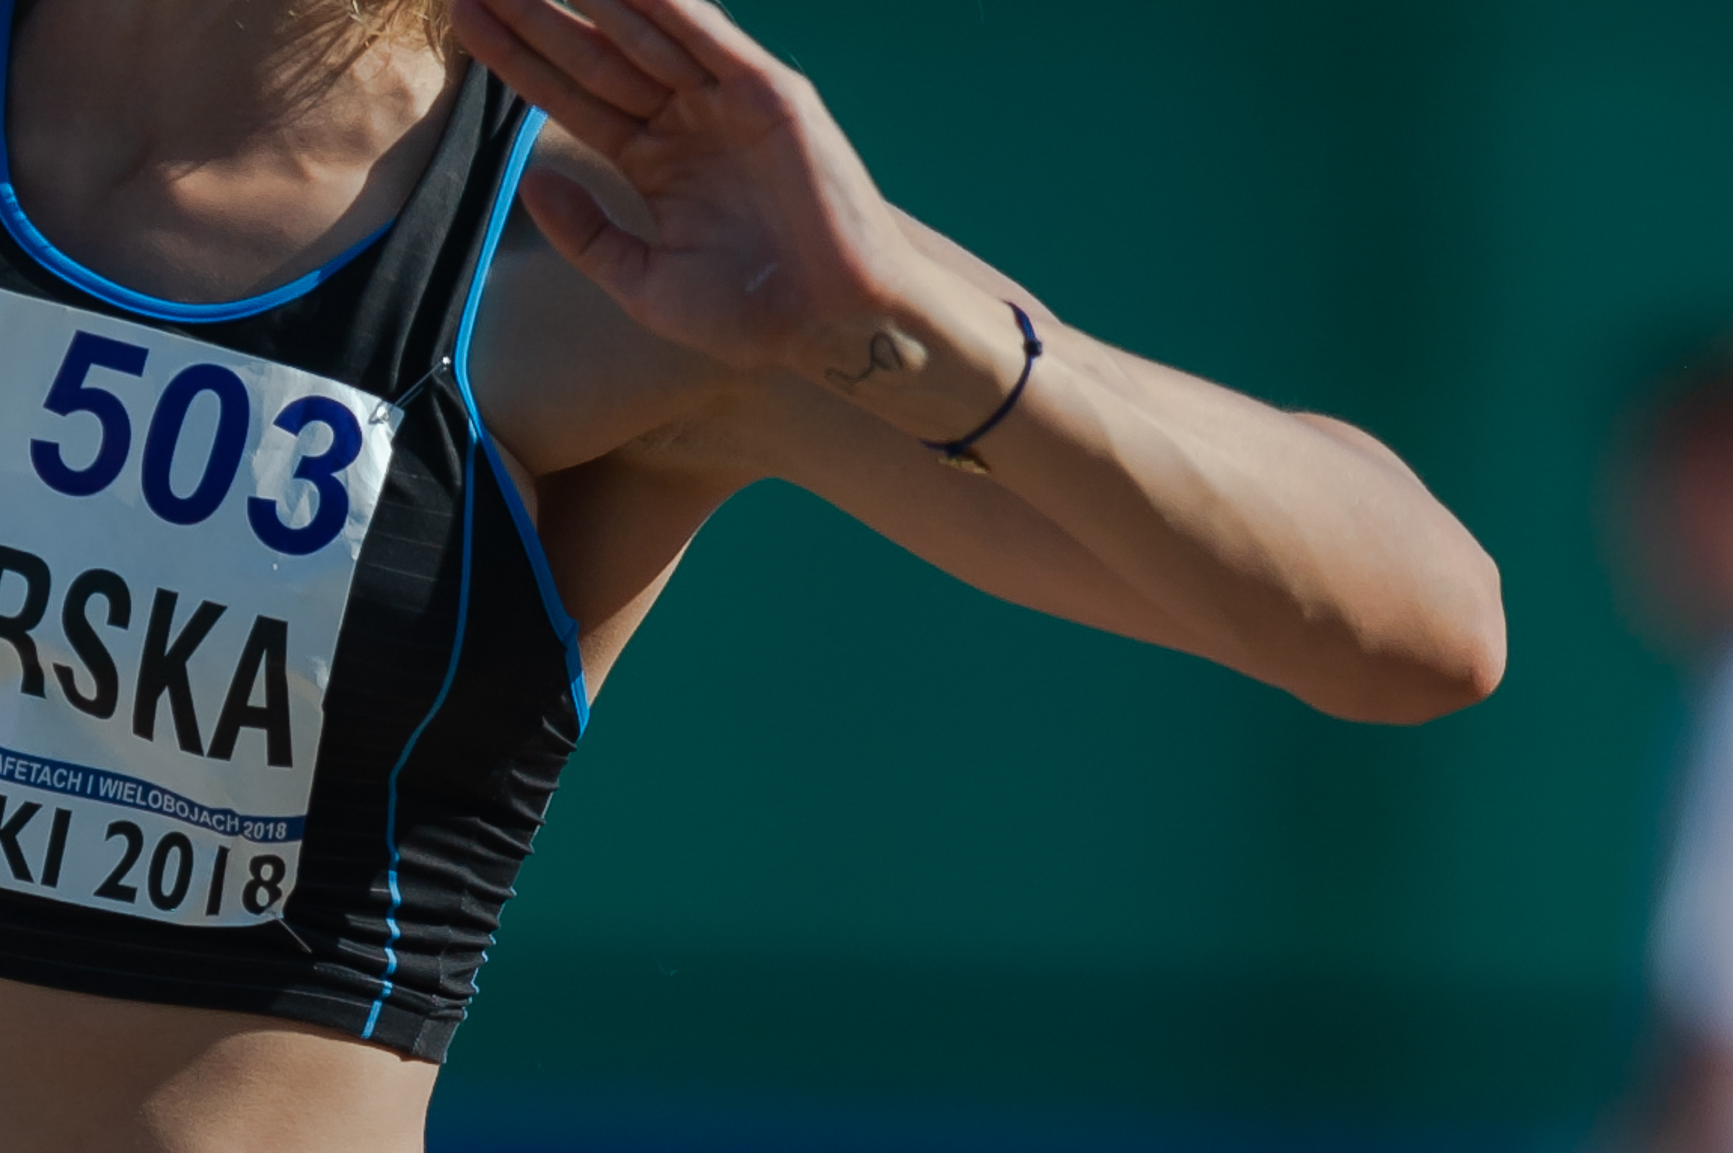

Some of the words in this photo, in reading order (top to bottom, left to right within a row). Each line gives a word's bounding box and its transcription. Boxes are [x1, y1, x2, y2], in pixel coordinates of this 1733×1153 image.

[30, 330, 363, 557] 503
[86, 774, 95, 795] I
[98, 776, 240, 834] WIELOBOJACH
[243, 820, 288, 841] 2018
[92, 819, 288, 918] 2018
